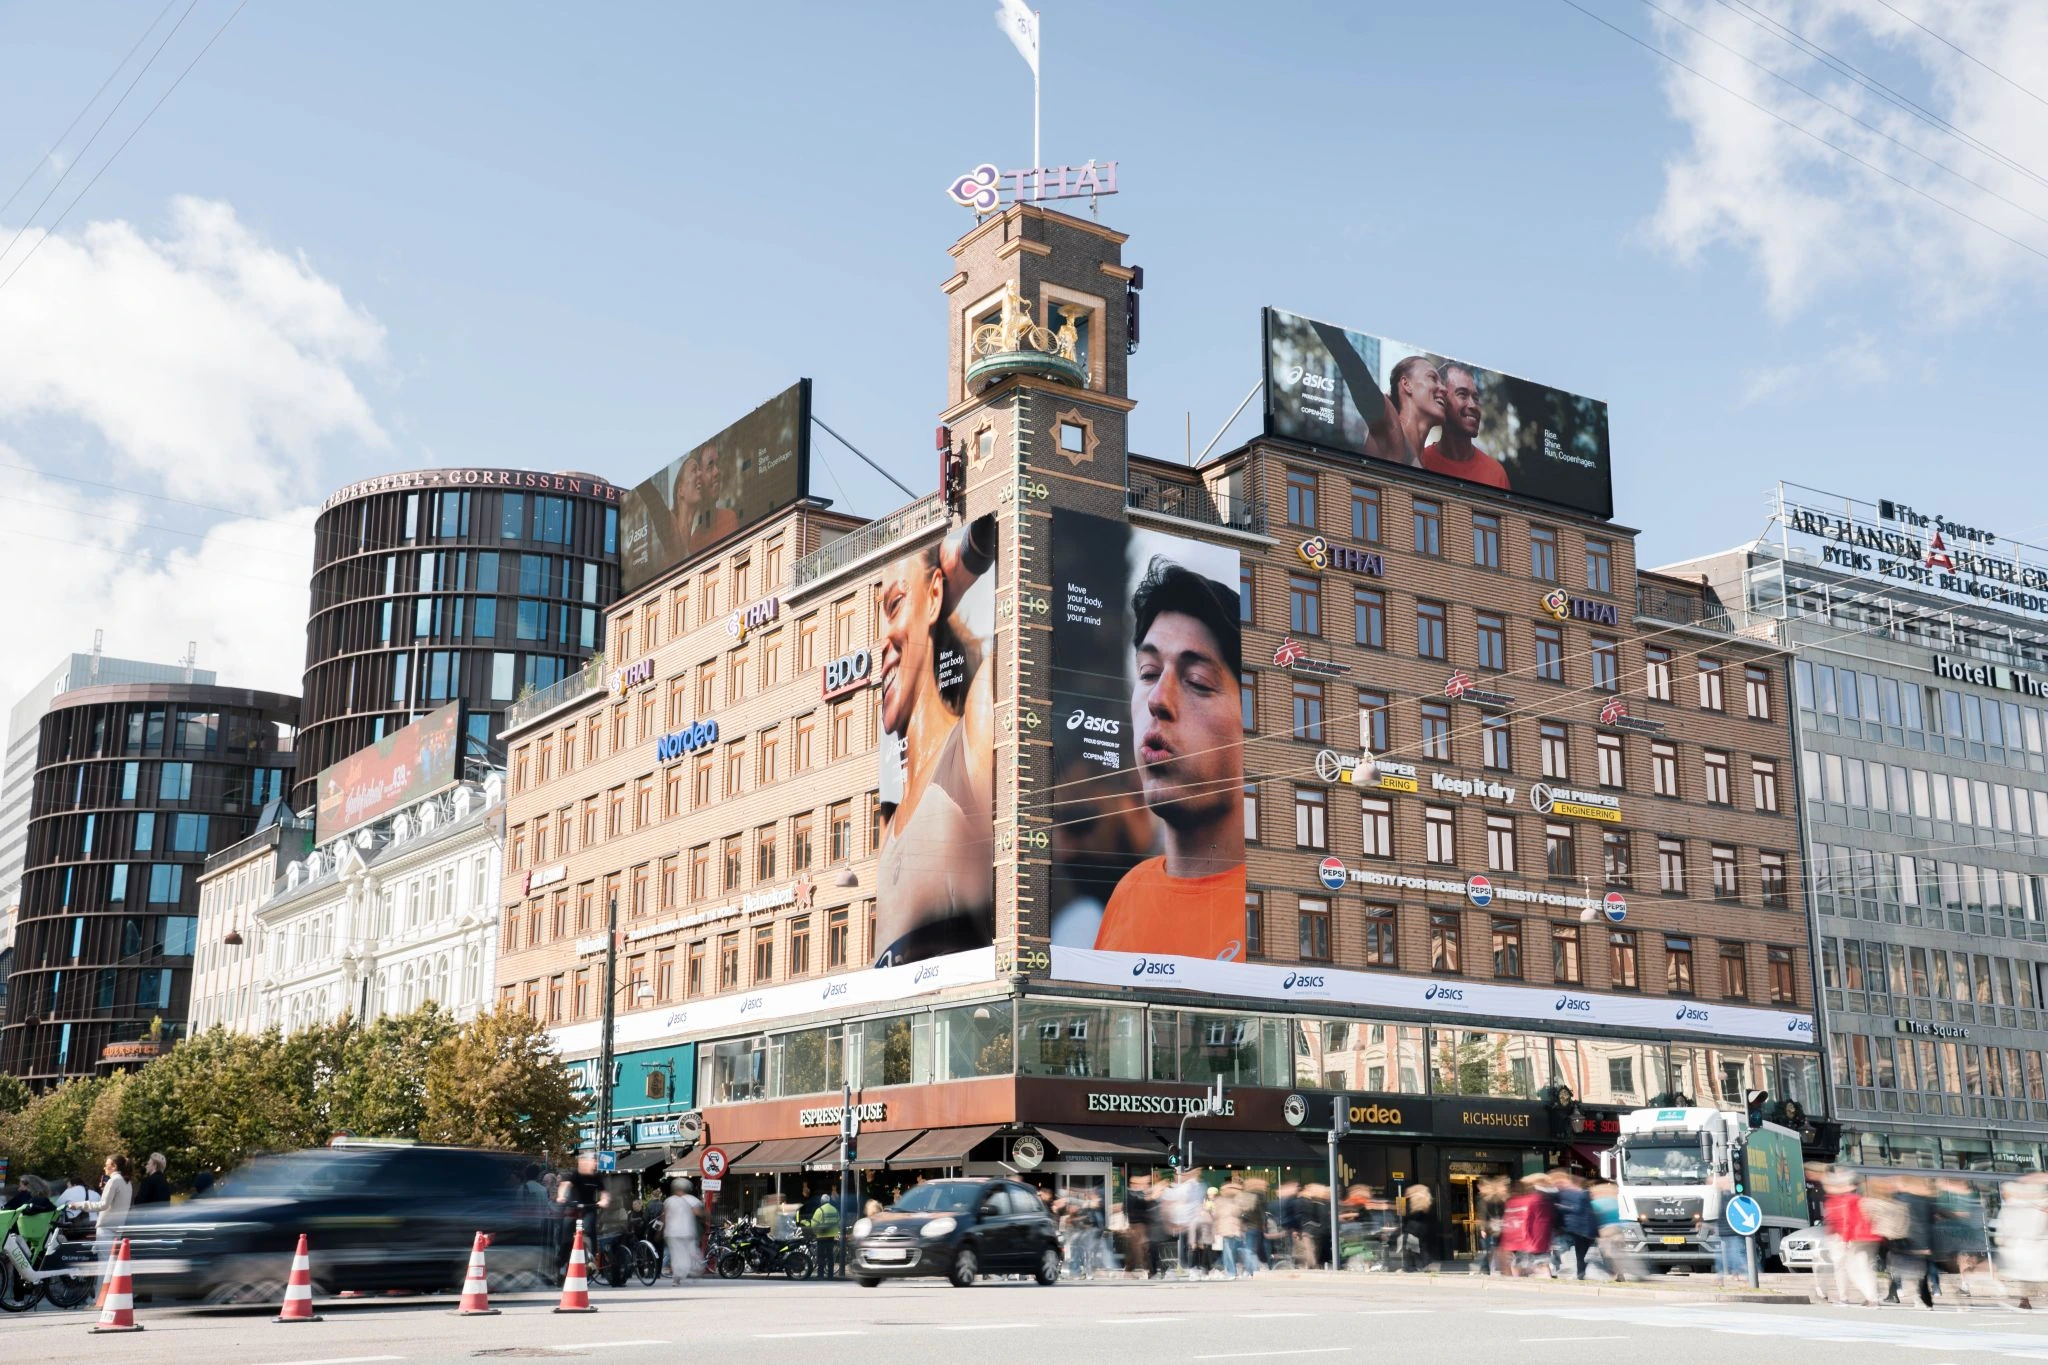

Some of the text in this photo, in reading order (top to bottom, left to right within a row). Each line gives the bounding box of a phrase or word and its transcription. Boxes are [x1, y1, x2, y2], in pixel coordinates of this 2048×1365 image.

[1003, 160, 1119, 201] THAI
[1302, 373, 1335, 392] asics
[1545, 438, 1562, 451] Shine.
[1545, 448, 1597, 468] Run, Copenhagen.
[329, 472, 425, 507] FEDERSPIEL
[449, 470, 581, 493] GORRISSEN
[1027, 481, 1048, 500] 20
[1896, 503, 1996, 545] The Square
[1329, 543, 1385, 577] THAI
[1822, 545, 1872, 571] BYENS
[1878, 558, 1934, 586] BEDSTE
[1067, 582, 1087, 595] Move
[1067, 594, 1103, 609] your body,
[1067, 603, 1087, 614] move
[743, 597, 779, 629] THAI
[1066, 613, 1101, 626] your mind
[1569, 596, 1618, 626] THAI
[940, 650, 953, 661] Move
[622, 659, 654, 688] THAI
[825, 648, 871, 691] BDO
[939, 660, 951, 672] your
[939, 669, 952, 680] move
[939, 673, 963, 691] your mind
[1935, 654, 2048, 698] Hotel The
[1084, 715, 1120, 734] asics
[657, 720, 718, 762] Nordea
[1340, 755, 1360, 767] RH
[1431, 772, 1516, 804] Keep it dry
[1551, 787, 1619, 807] RH PUMPER
[1561, 805, 1615, 820] ENGINEERING
[1323, 869, 1345, 878] PEPSI
[1348, 870, 1466, 895] THIRSTY FOR MORE
[743, 881, 796, 914] Heineken
[1470, 886, 1491, 895] PEPSI
[1494, 887, 1603, 910] THIRSTY FOR MORE
[1606, 902, 1626, 911] PEPSI
[1027, 951, 1048, 970] 20
[1147, 962, 1175, 975] asics
[922, 964, 940, 979] asics
[829, 982, 848, 996] asics
[1297, 976, 1324, 988] asics
[747, 996, 762, 1010] asics
[1438, 987, 1463, 1001] asics
[1567, 998, 1590, 1011] asics
[672, 1011, 687, 1025] asics
[1686, 1008, 1709, 1021] asics
[1908, 1020, 1970, 1039] The Square
[1087, 1093, 1235, 1116] ESPRESSO HOE
[800, 1102, 884, 1127] ESPRESSO OUSE
[1349, 1103, 1529, 1127] ordea RICHSHUSET
[2002, 1153, 2035, 1164] The Square
[1654, 1207, 1685, 1216] MAN
